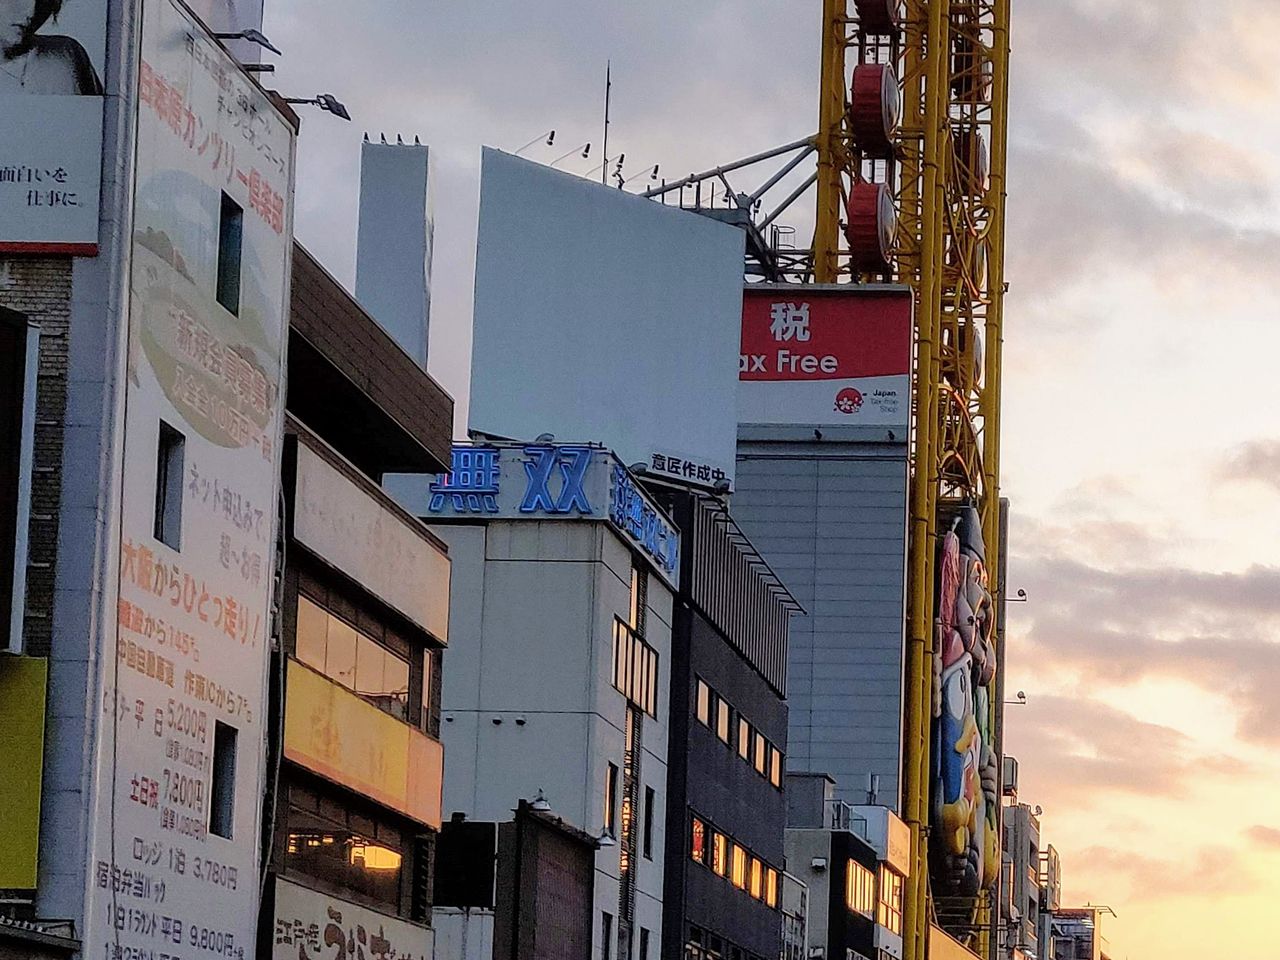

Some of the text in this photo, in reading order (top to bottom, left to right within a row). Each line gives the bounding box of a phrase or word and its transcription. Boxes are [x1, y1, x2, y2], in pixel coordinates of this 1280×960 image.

[739, 348, 838, 374] ax Free
[872, 388, 897, 398] Japan
[652, 453, 726, 482] 意匠作成中
